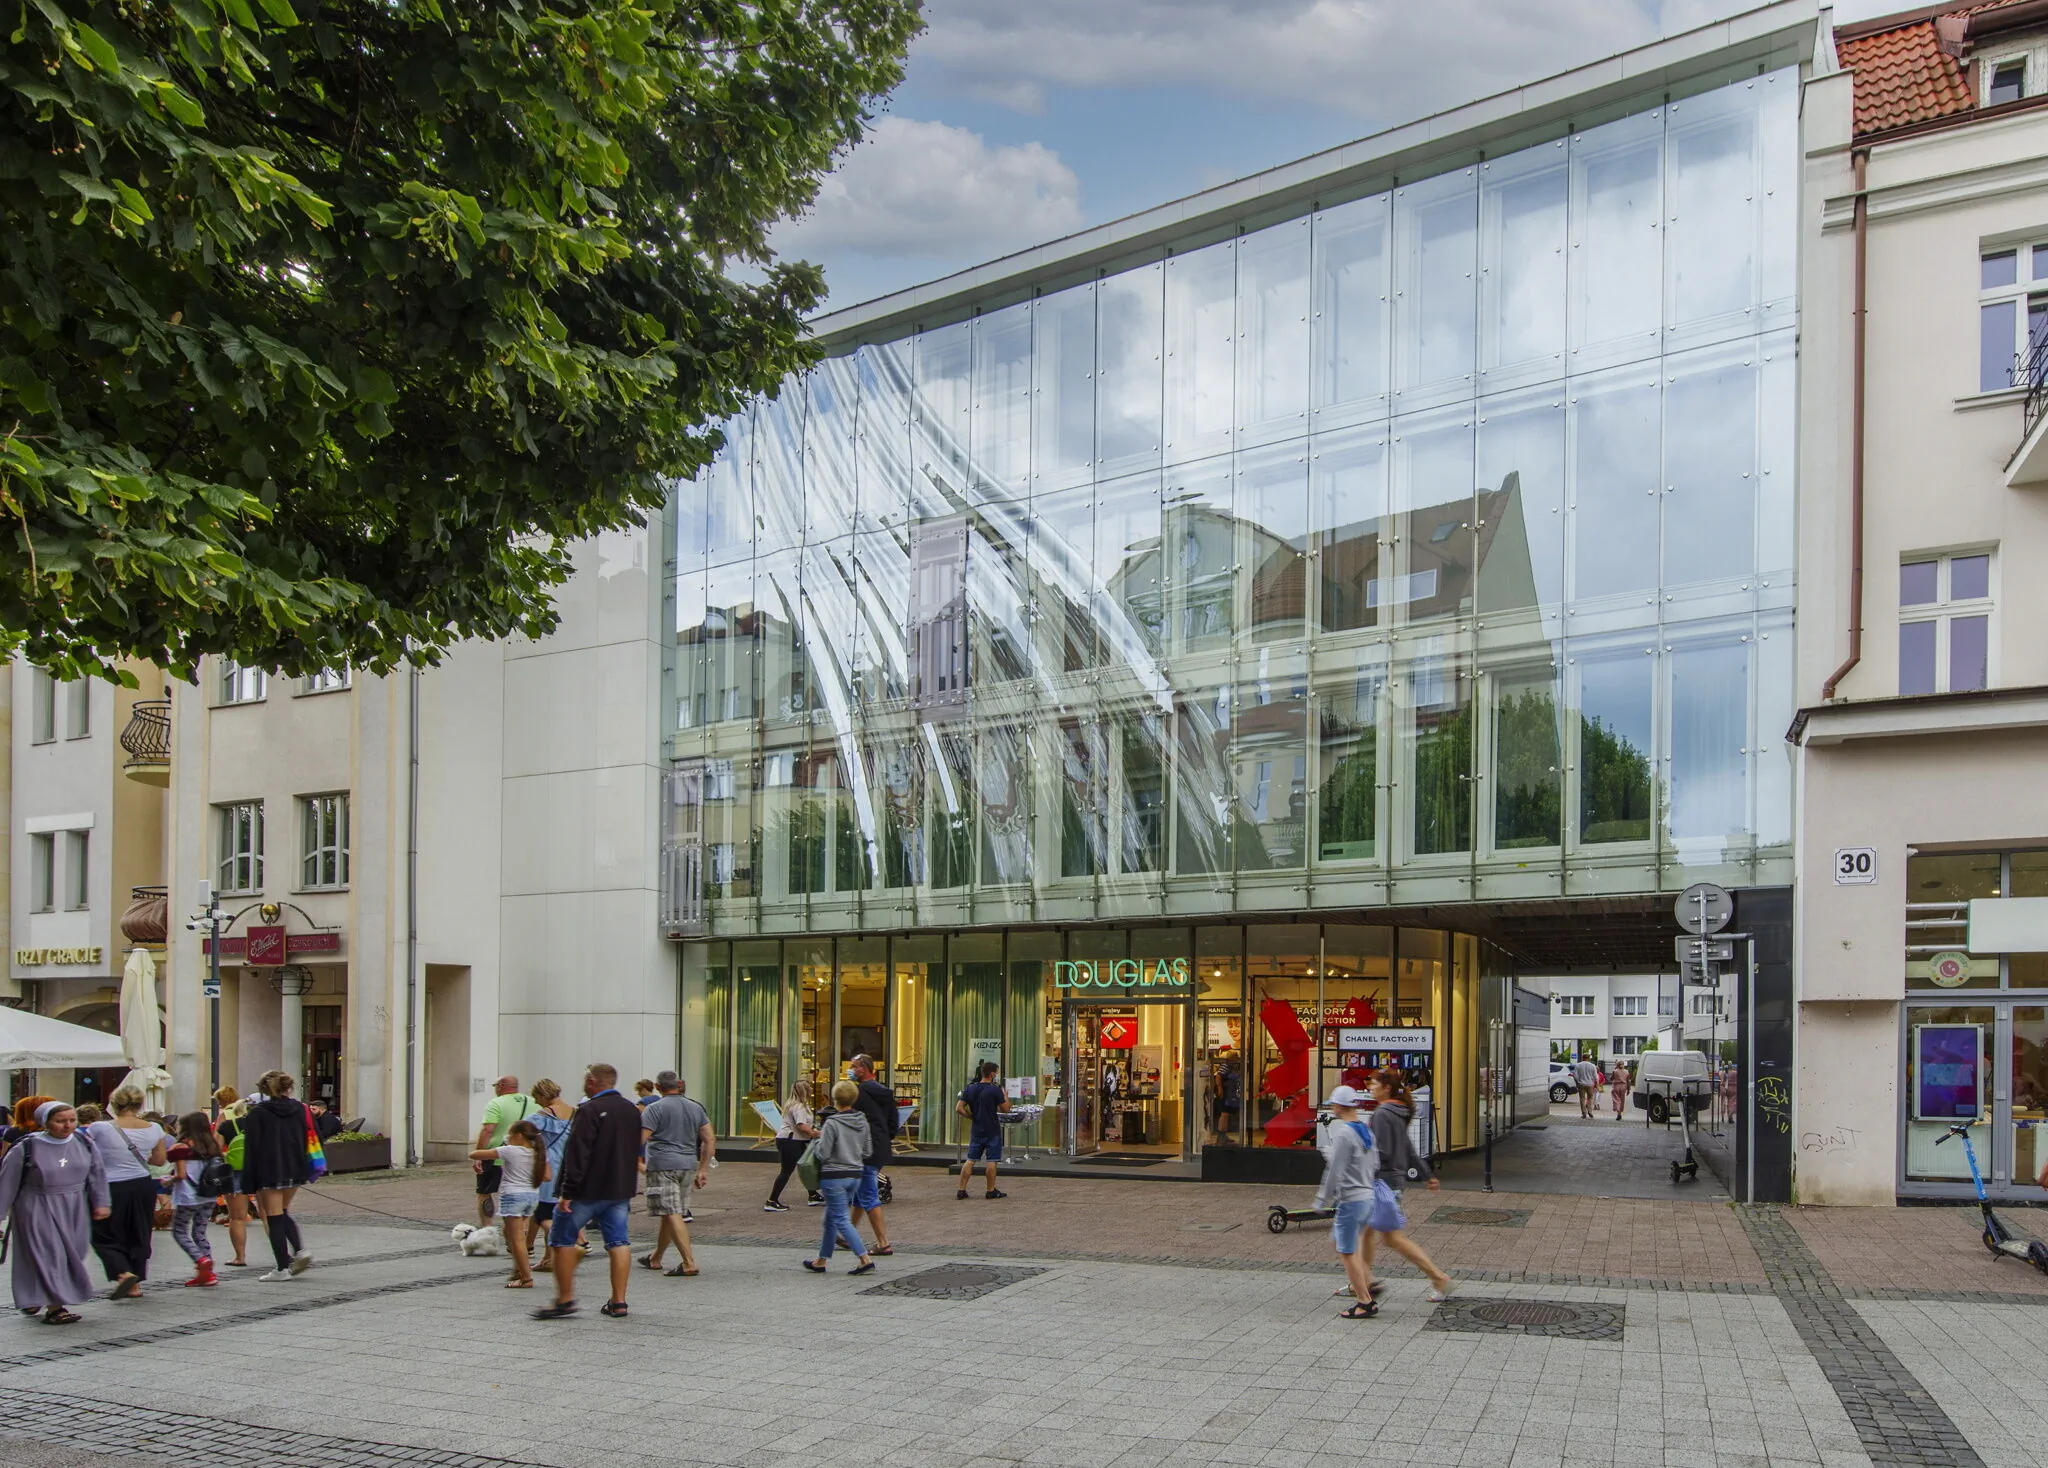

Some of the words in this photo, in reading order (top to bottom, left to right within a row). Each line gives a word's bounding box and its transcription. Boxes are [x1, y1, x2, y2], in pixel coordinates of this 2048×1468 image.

[1840, 853, 1871, 873] 30
[14, 948, 46, 966] TRZY
[46, 945, 103, 966] GRACJE
[1055, 957, 1188, 988] DOUGLAS
[1297, 1007, 1346, 1015] FACORY
[1349, 1007, 1356, 1015] 5
